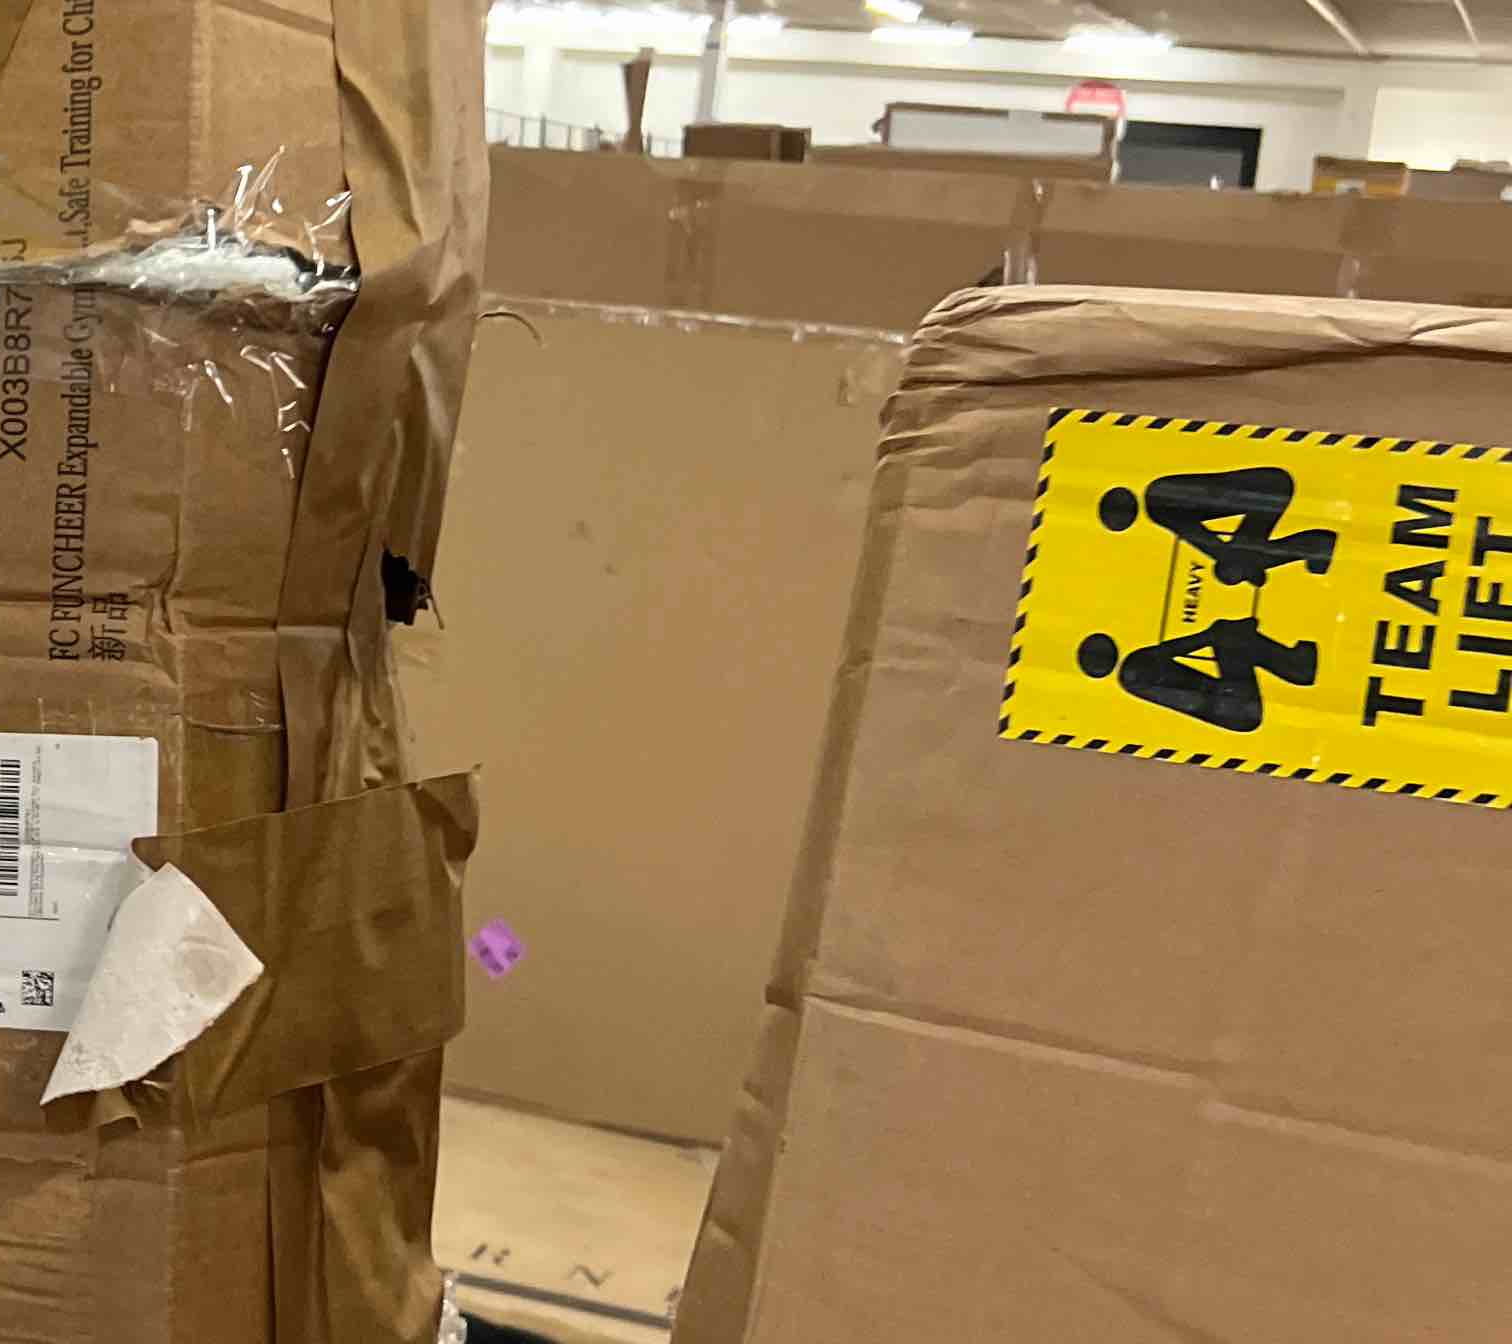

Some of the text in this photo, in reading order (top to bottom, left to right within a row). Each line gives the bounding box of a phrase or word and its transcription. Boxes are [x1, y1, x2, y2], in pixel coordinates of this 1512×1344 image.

[62, 43, 94, 75] for
[59, 76, 102, 173] Training
[0, 238, 33, 461] X003B8R7J
[58, 348, 99, 478] Expandable
[51, 483, 88, 623] FUNCHEER
[1181, 561, 1204, 623] HEAVY
[1361, 483, 1459, 728] TEAM
[49, 628, 81, 661] FC
[89, 592, 129, 662] 新品
[1448, 516, 1512, 712] LIFT
